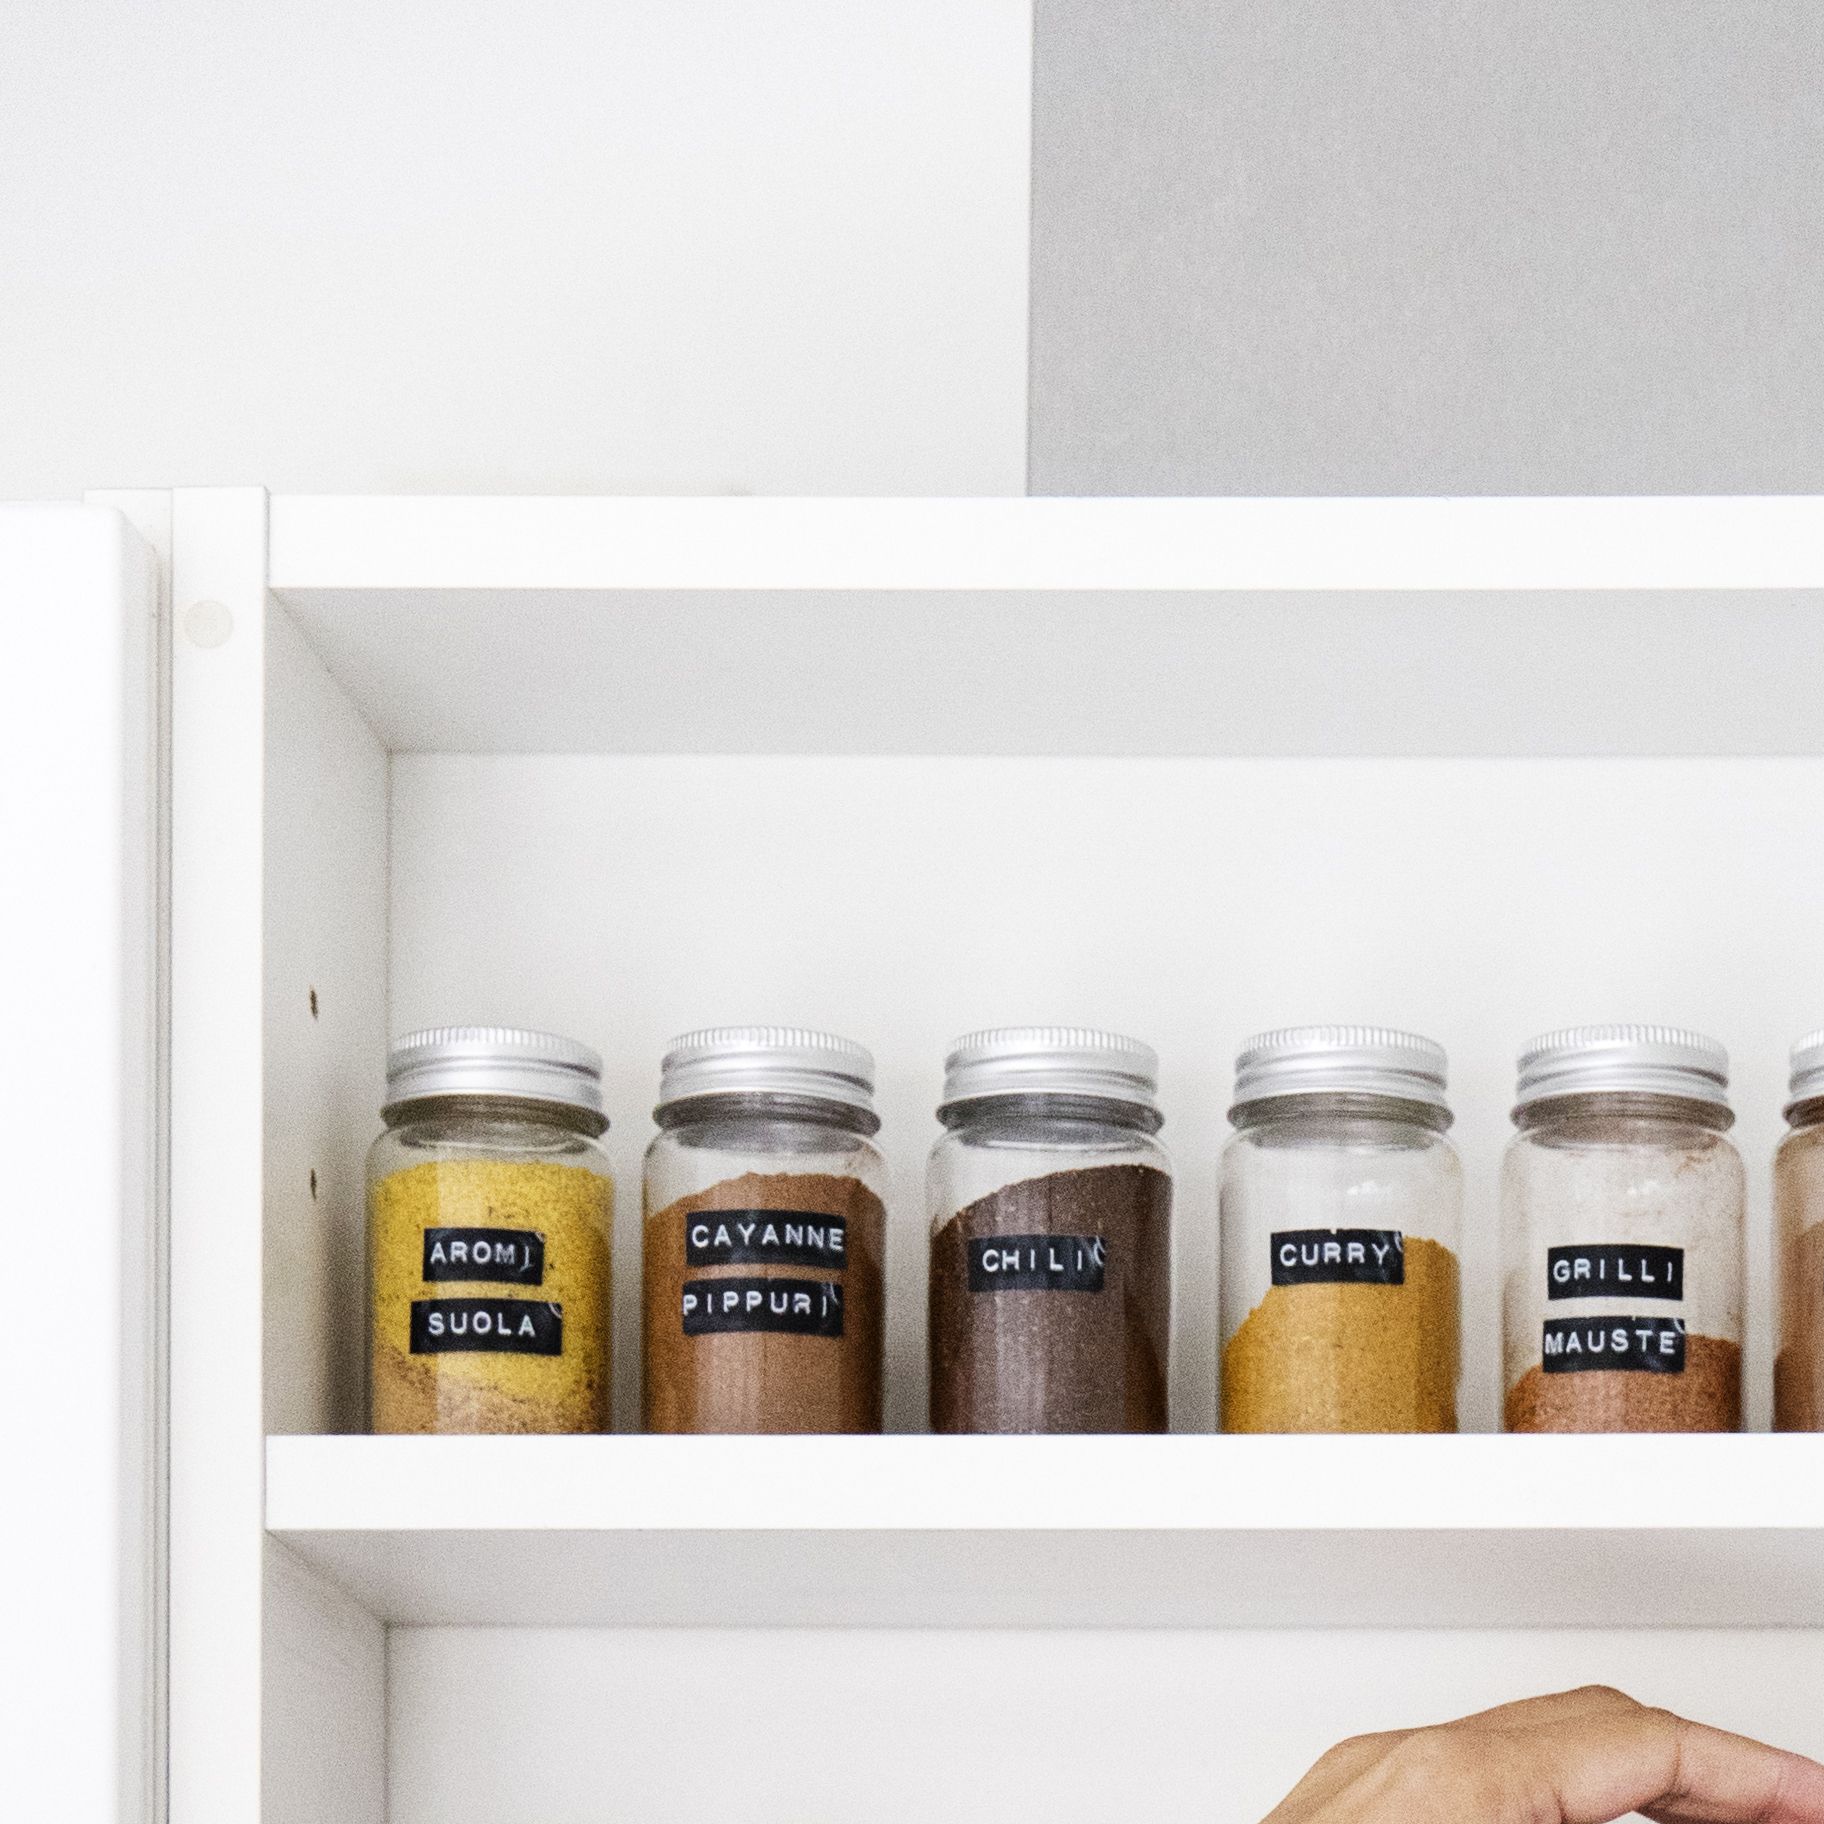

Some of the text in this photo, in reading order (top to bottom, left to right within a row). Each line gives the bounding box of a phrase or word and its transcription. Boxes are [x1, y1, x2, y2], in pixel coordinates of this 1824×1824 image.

[691, 1223, 845, 1252] CAYANNE
[430, 1240, 531, 1267] AROMI
[982, 1248, 1083, 1273] CHILI
[1279, 1242, 1389, 1267] CURRY
[1553, 1257, 1675, 1284] GRILLI
[682, 1291, 829, 1319] PIPPURI
[428, 1311, 536, 1338] SUOLA
[1544, 1329, 1677, 1356] MAUSTE
